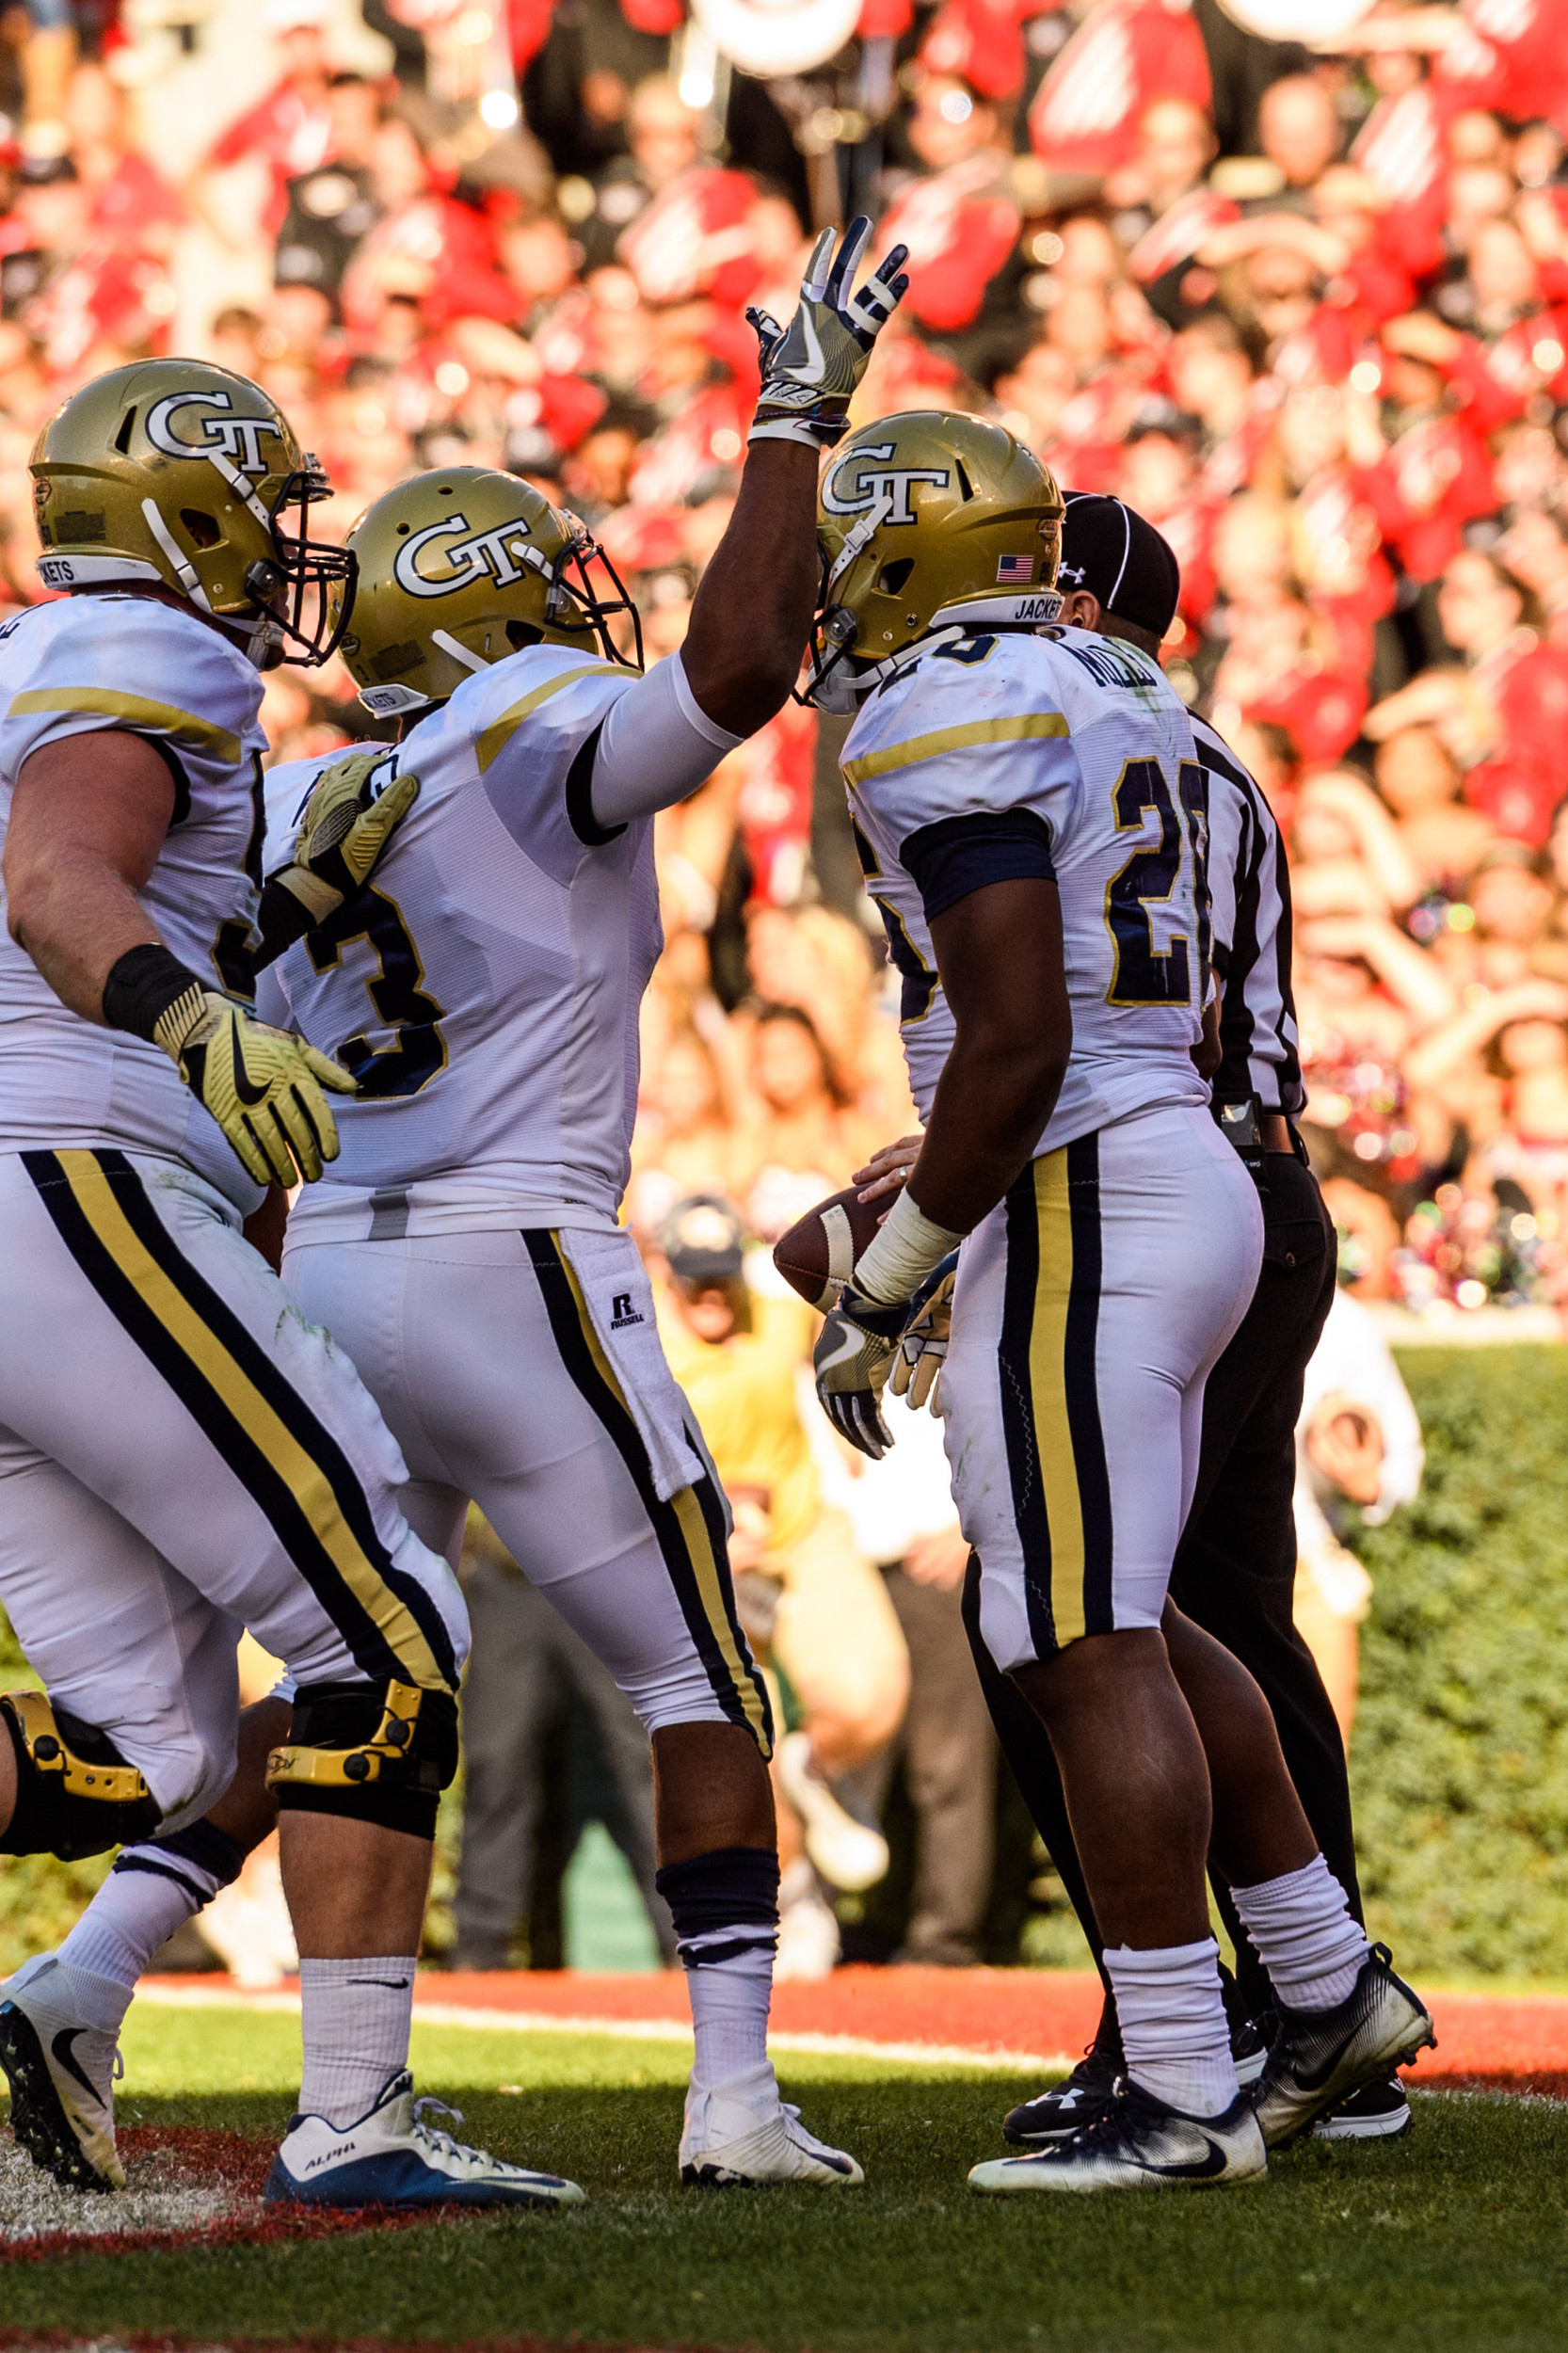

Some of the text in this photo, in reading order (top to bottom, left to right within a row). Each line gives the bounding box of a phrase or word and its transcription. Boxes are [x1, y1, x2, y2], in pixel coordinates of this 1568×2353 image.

[145, 392, 280, 474] GT
[822, 442, 951, 526] GT
[392, 514, 531, 599] GT
[610, 1314, 645, 1330] RUSSELL
[304, 2141, 356, 2171] ALPHA
